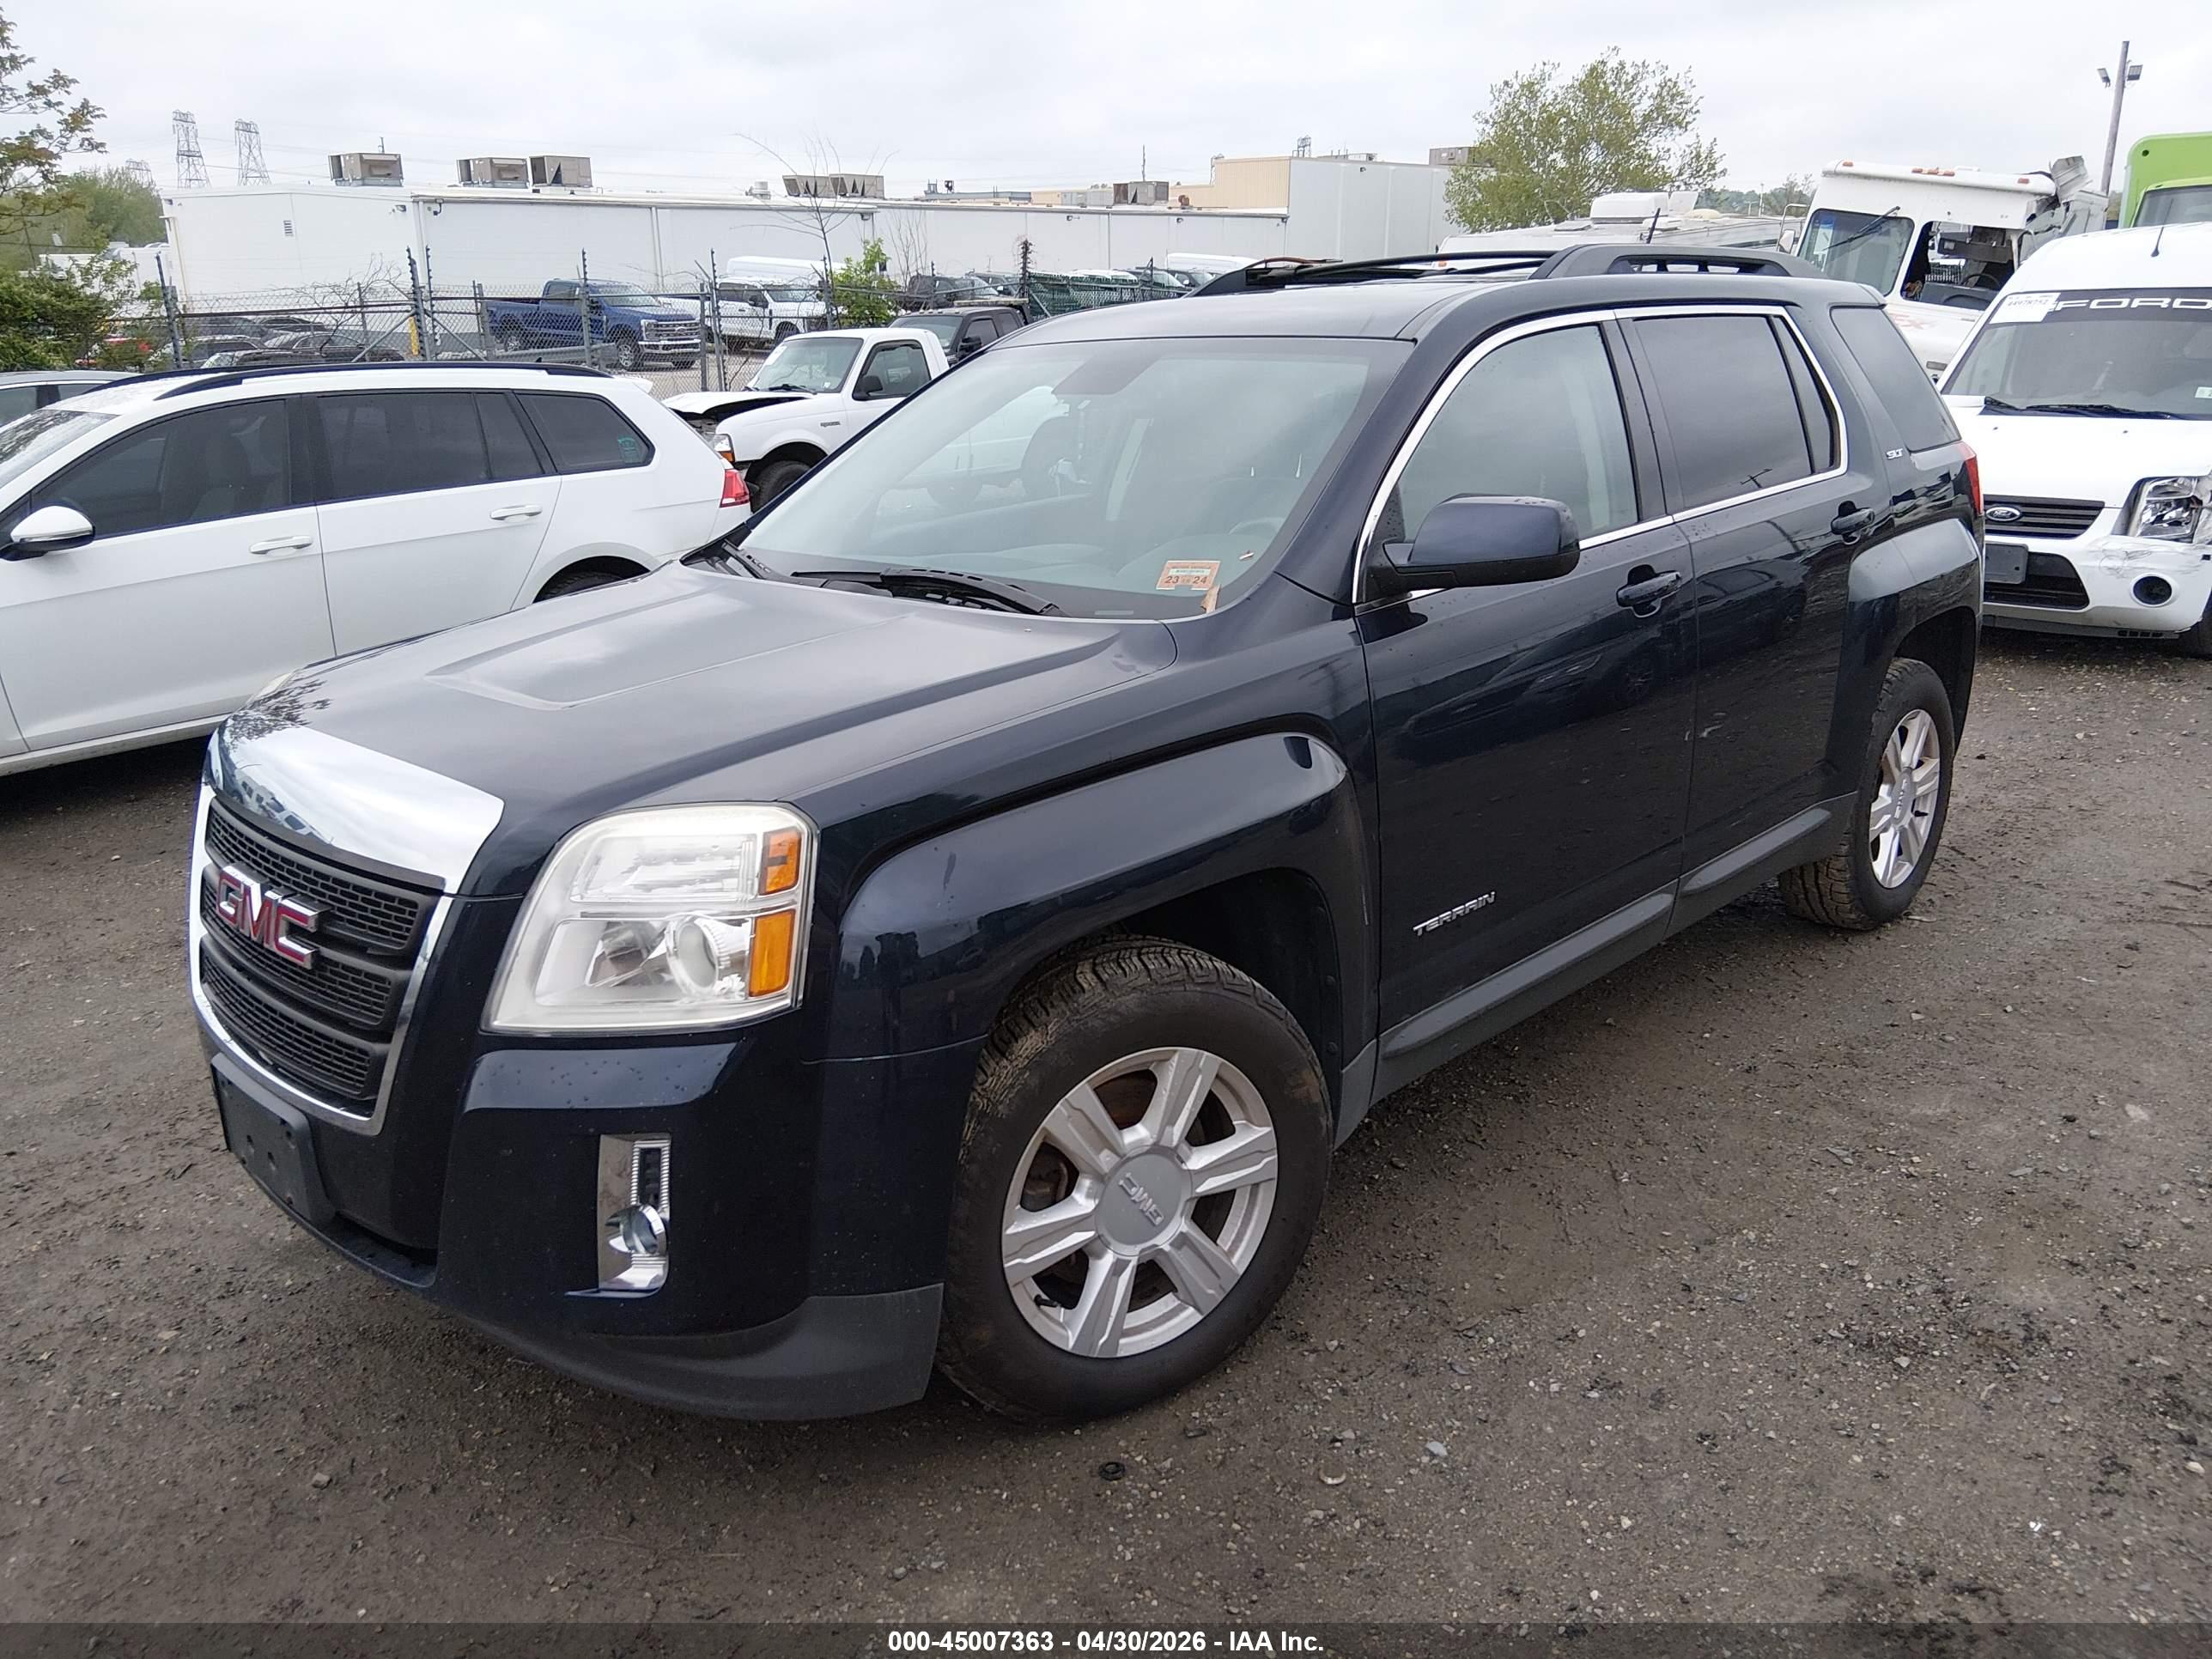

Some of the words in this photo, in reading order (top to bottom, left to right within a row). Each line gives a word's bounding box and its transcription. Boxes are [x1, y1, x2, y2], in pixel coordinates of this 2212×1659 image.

[2054, 297, 2212, 312] FORD
[1164, 575, 1180, 584] 23
[1193, 575, 1207, 584] 24
[216, 866, 318, 969] GMC
[1413, 891, 1495, 936] TERRAIN
[1119, 1172, 1164, 1225] GMC
